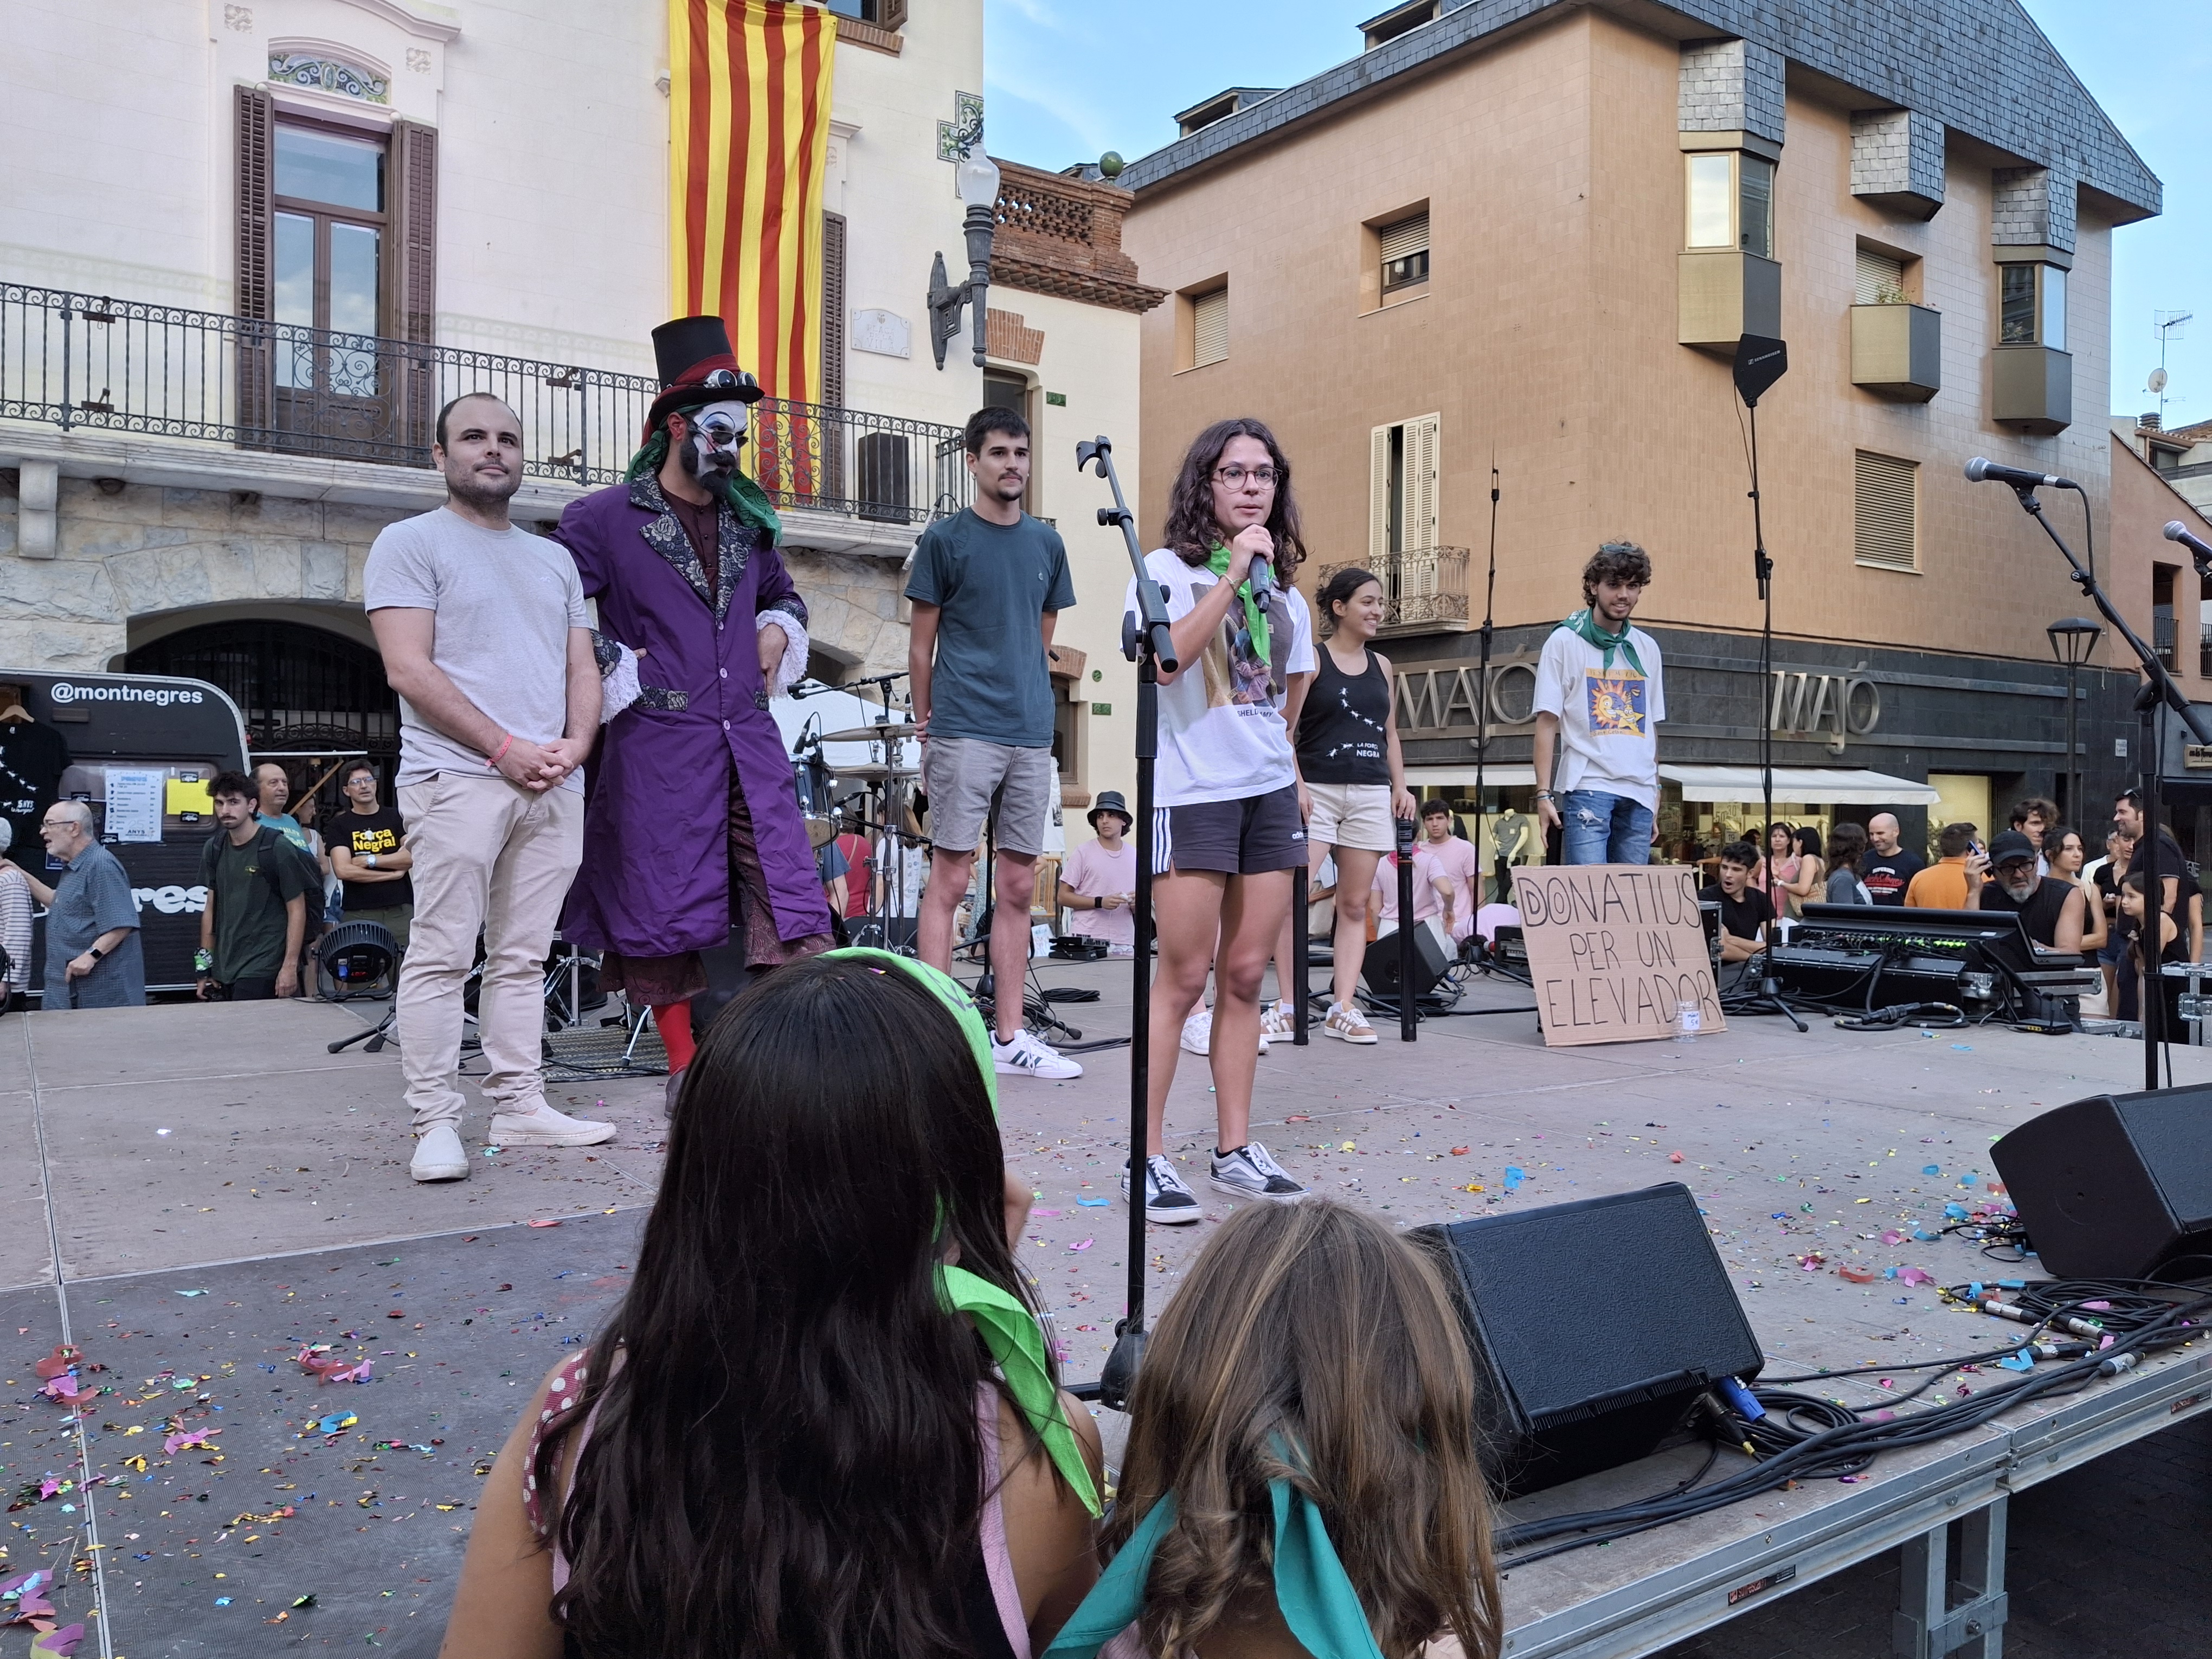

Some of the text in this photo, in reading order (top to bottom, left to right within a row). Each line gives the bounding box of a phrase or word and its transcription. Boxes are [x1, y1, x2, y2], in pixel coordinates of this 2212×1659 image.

[866, 338, 895, 351] VILA
[51, 682, 203, 706] @montnegres
[1356, 749, 1380, 758] NEGRA
[352, 829, 393, 840] Força
[353, 836, 396, 852] Negra!
[1517, 872, 1701, 928] DONATIUS
[1570, 930, 1676, 971] PER UN
[1546, 970, 1722, 1027] ELEVADOR
